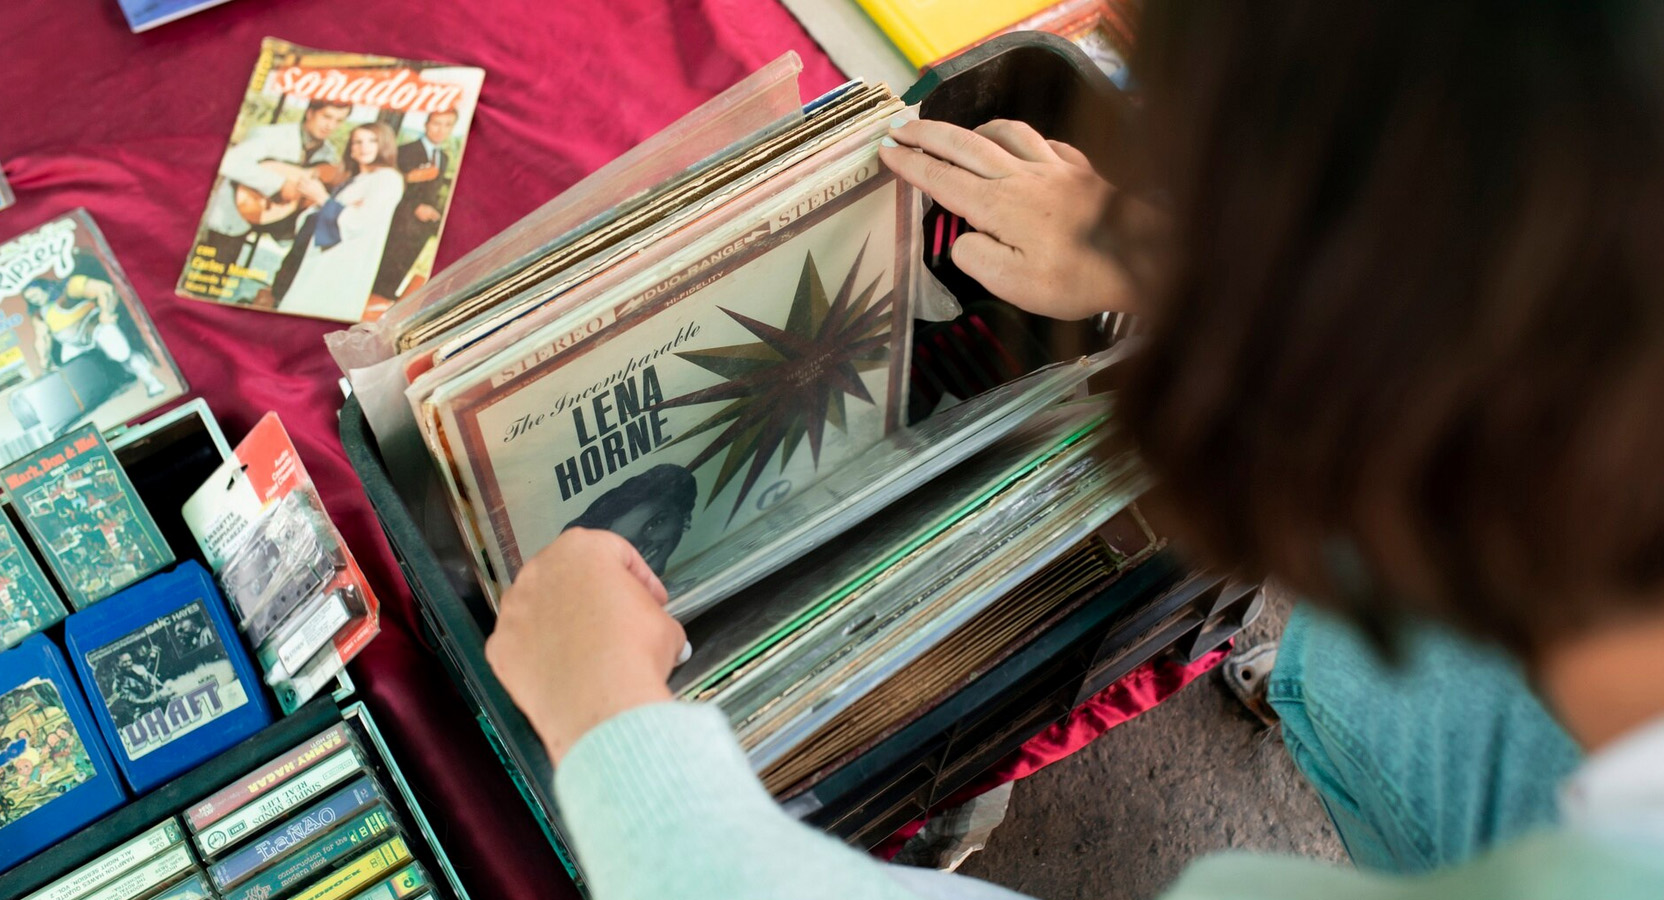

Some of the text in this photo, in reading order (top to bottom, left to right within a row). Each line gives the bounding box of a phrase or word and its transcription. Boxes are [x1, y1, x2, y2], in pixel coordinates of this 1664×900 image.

[778, 166, 869, 228] STEREO
[644, 238, 746, 301] DUO-RANGE
[664, 270, 725, 307] HI-FIDELITY
[502, 317, 603, 381] STEREO
[503, 413, 545, 443] The
[550, 320, 701, 417] Incomparable
[572, 364, 664, 448] LENA
[38, 451, 66, 472] Don
[63, 444, 76, 459] &
[554, 410, 673, 502] HORNE
[171, 602, 200, 622] HAYES
[295, 733, 342, 766] SAMMY
[246, 761, 295, 794] HAGAR
[251, 781, 321, 826] SIMPLE MINDS
[258, 780, 307, 813] REAL LIFE
[105, 854, 135, 874] HAMPTON
[119, 849, 132, 859] ALL
[276, 849, 322, 880] construction
[321, 842, 334, 853] for
[334, 835, 348, 846] the
[279, 855, 327, 887] modern idiot
[81, 871, 104, 887] HAWES
